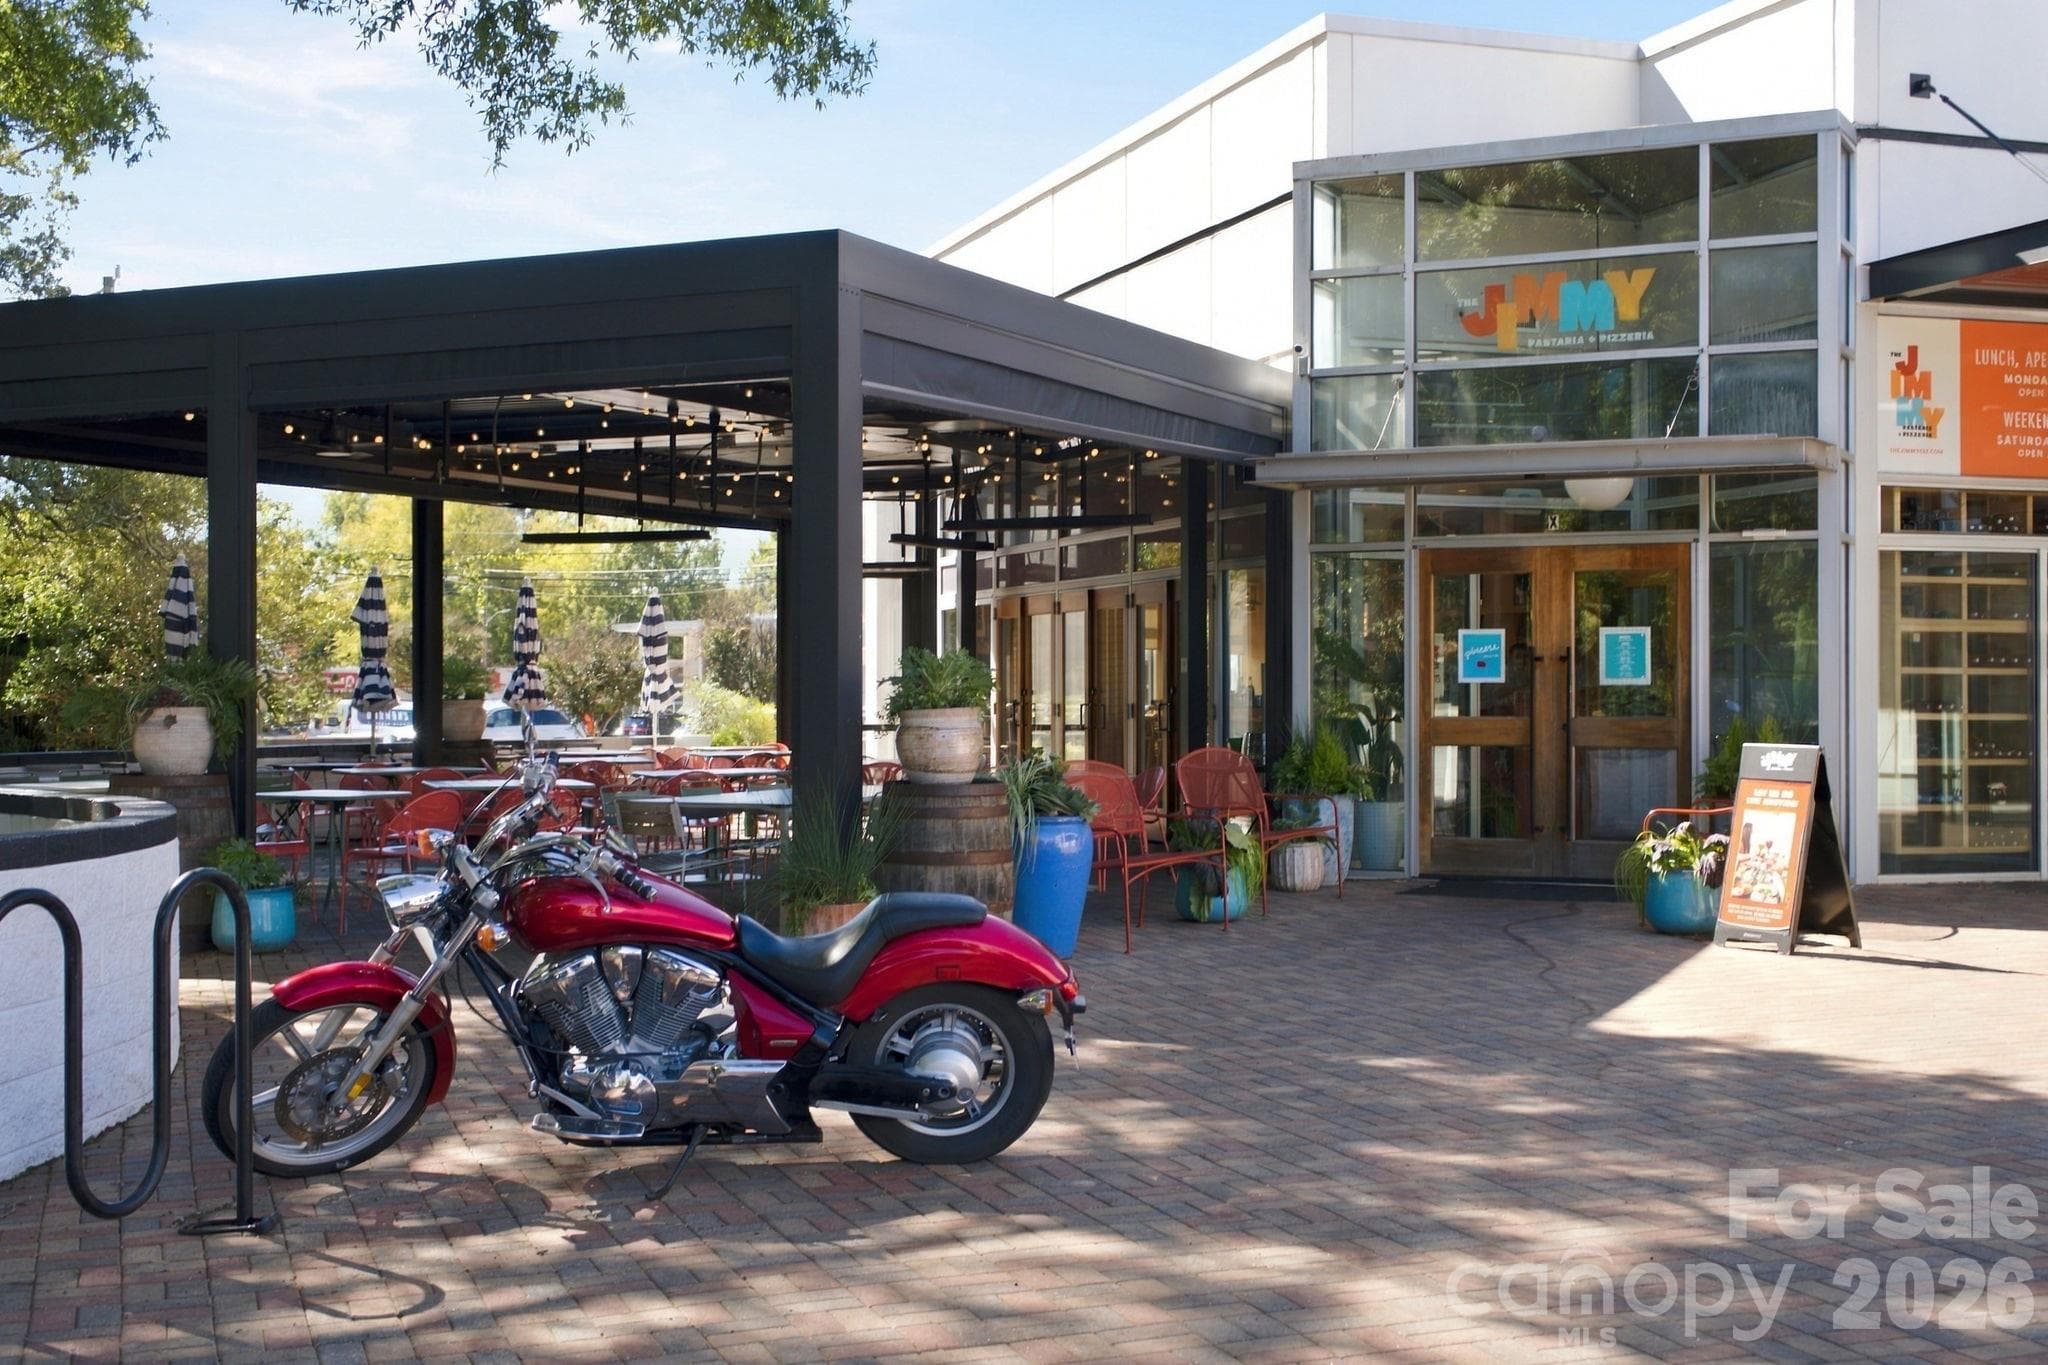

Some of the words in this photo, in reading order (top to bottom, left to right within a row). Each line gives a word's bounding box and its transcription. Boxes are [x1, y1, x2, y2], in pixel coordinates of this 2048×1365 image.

[1456, 298, 1479, 307] THE
[1460, 267, 1657, 351] JIMMY
[1527, 335, 1584, 348] PASTARIA
[1599, 330, 1655, 344] PIZZERIA
[1975, 349, 2020, 368] LUNCH,
[2018, 388, 2044, 397] OPEN
[2017, 449, 2044, 458] OPEN
